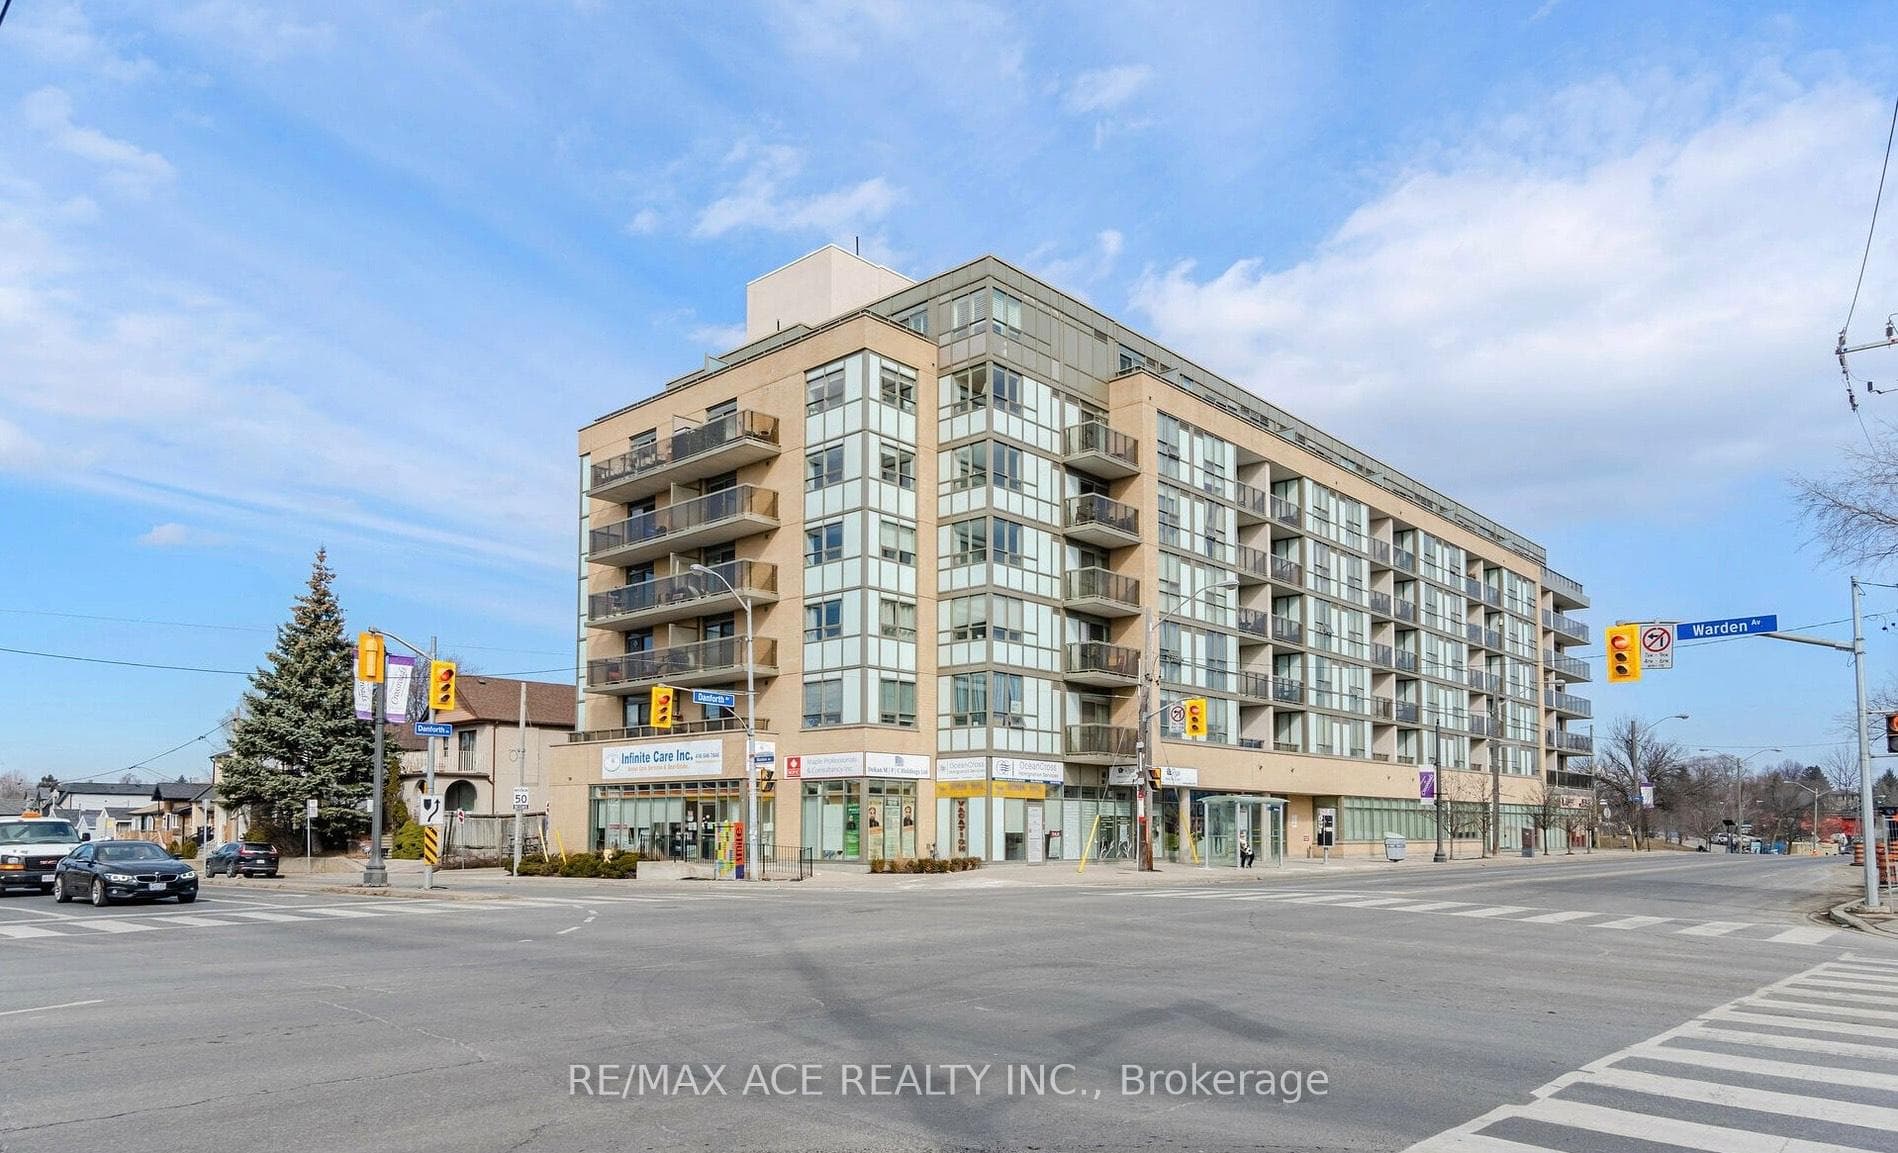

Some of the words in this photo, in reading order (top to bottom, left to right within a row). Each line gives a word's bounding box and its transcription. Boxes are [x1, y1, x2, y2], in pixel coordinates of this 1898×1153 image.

[1692, 622, 1748, 637] Warden
[698, 693, 725, 704] Danforth
[417, 724, 445, 734] Danforth
[621, 751, 651, 764] Infinite
[653, 750, 674, 763] Care
[676, 749, 694, 761] Inc.
[1019, 761, 1058, 772] OceanCross
[515, 794, 528, 804] 50
[957, 800, 966, 852] VACATION
